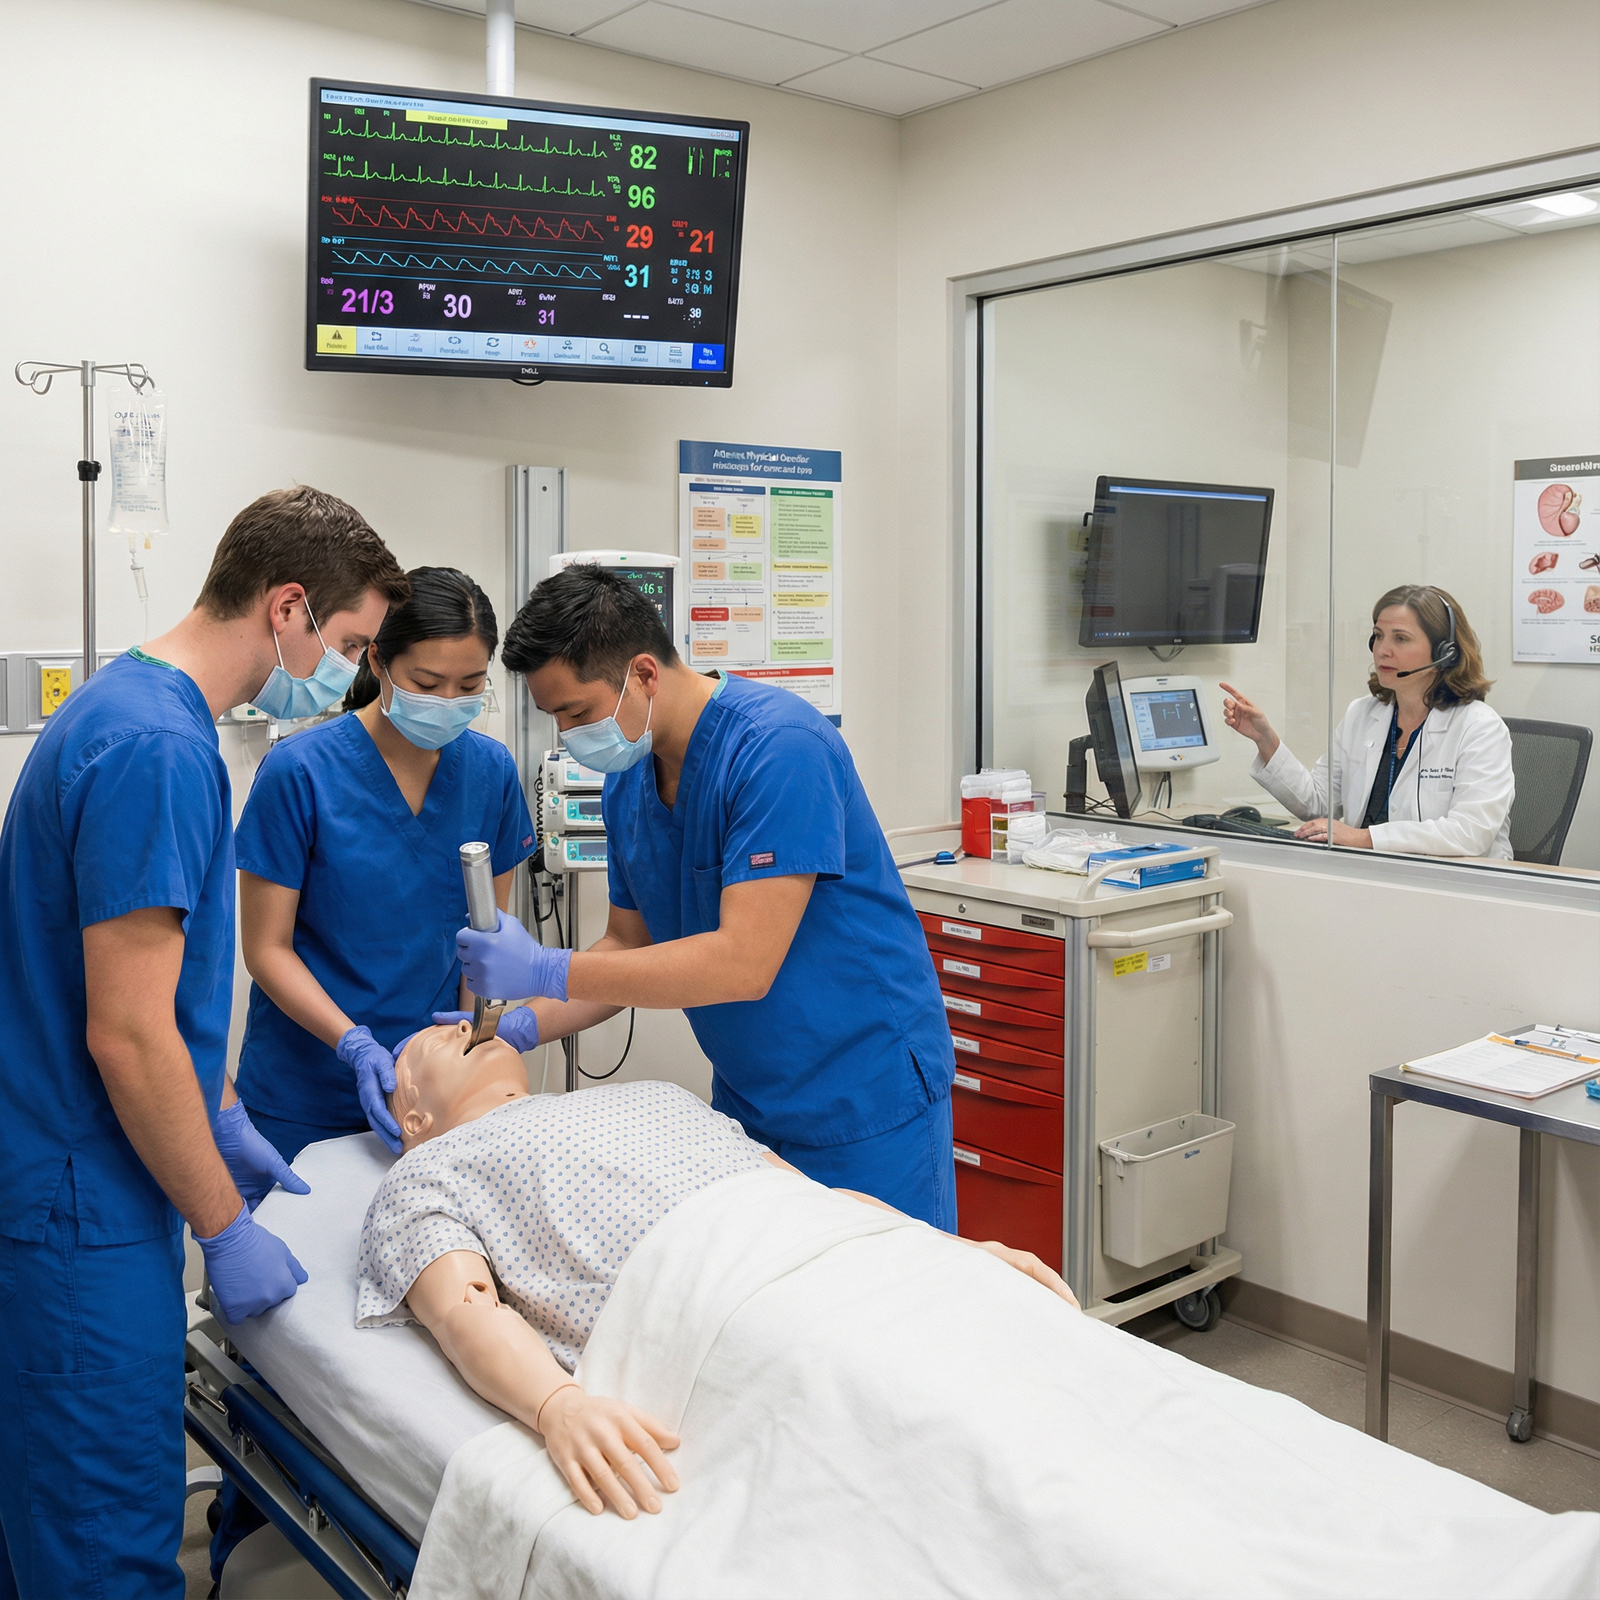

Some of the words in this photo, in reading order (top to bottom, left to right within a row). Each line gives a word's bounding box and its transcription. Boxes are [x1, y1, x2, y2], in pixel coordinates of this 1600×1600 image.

[629, 144, 658, 170] 82
[627, 184, 656, 209] 96
[626, 224, 654, 249] 29
[689, 229, 714, 254] 21
[624, 264, 650, 288] 31
[340, 287, 395, 315] 21/3
[443, 293, 472, 319] 30
[538, 309, 555, 325] 31
[750, 462, 762, 472] for
